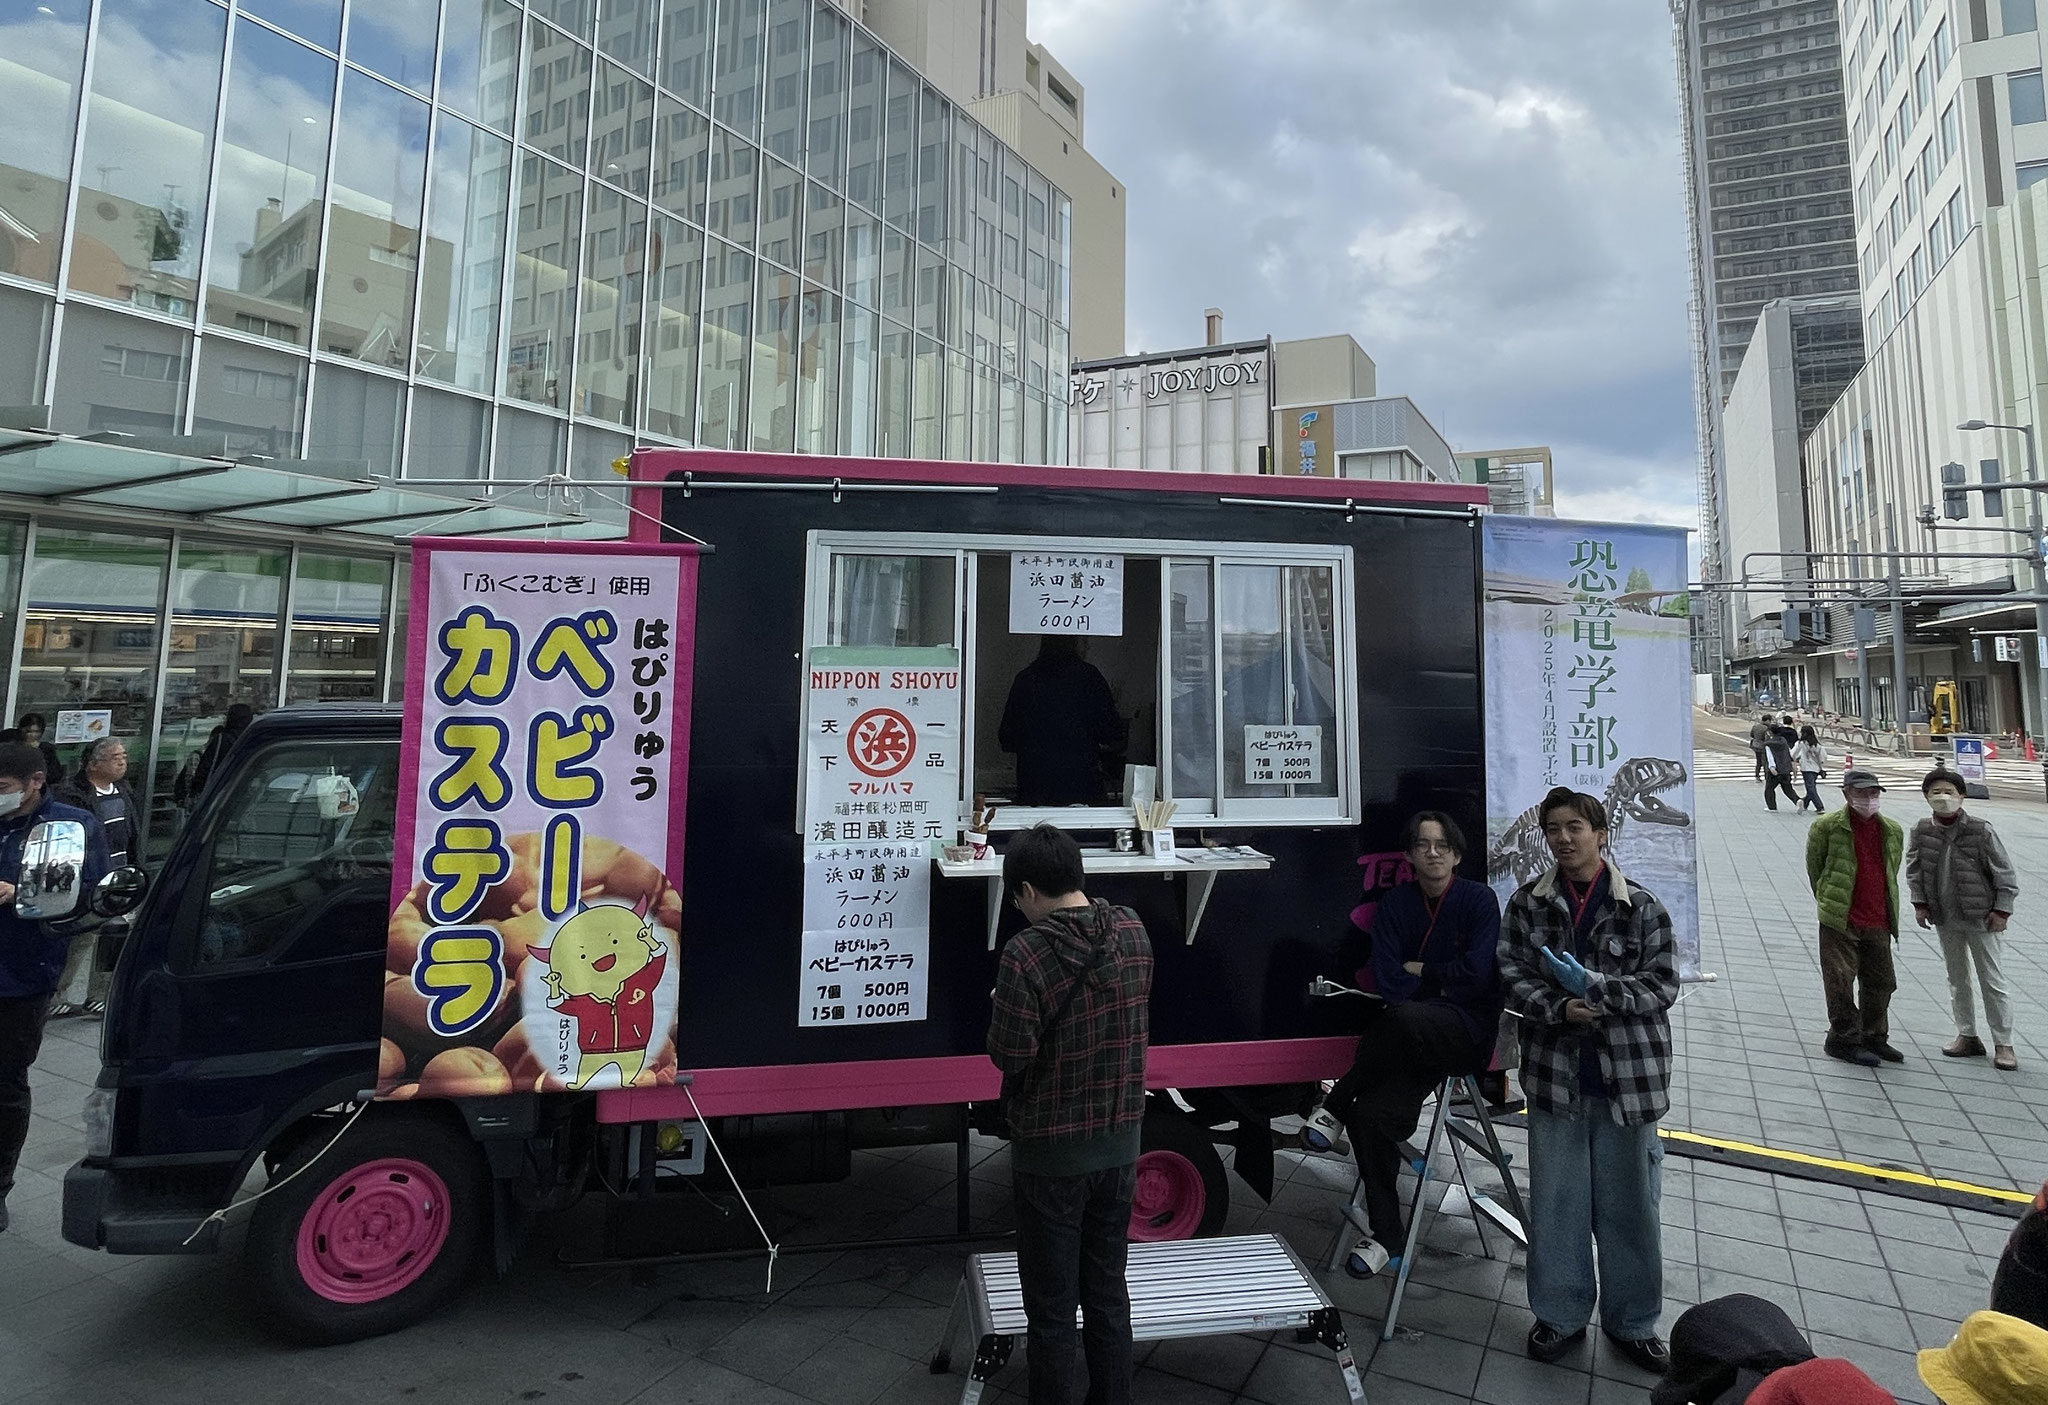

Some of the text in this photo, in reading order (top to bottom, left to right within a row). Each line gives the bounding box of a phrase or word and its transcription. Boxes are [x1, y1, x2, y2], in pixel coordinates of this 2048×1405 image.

[1039, 593, 1095, 609] ラーメン
[1040, 615, 1090, 631] 600円
[1567, 539, 1618, 769] 恐竜学部
[811, 671, 959, 690] NIPPON SHOYU
[1542, 608, 1558, 787] 2025年4月設置予定
[630, 618, 670, 801] はぴりゅう
[820, 719, 839, 771] 天下
[1250, 741, 1312, 751] ベビーカステラ
[527, 609, 618, 922] ベビー
[1284, 758, 1311, 767] 500円
[1280, 770, 1312, 780] 1000円
[848, 782, 914, 795] マルハマ
[414, 604, 520, 1035] カステラ
[1357, 852, 1414, 890] TEA
[836, 890, 898, 907] ラーメン
[837, 911, 893, 929] 600円
[834, 938, 890, 953] はぴりゅう
[809, 954, 914, 972] ベビーカステラ
[817, 981, 909, 999] 7個 500円
[812, 1002, 910, 1020] 15個 1000円
